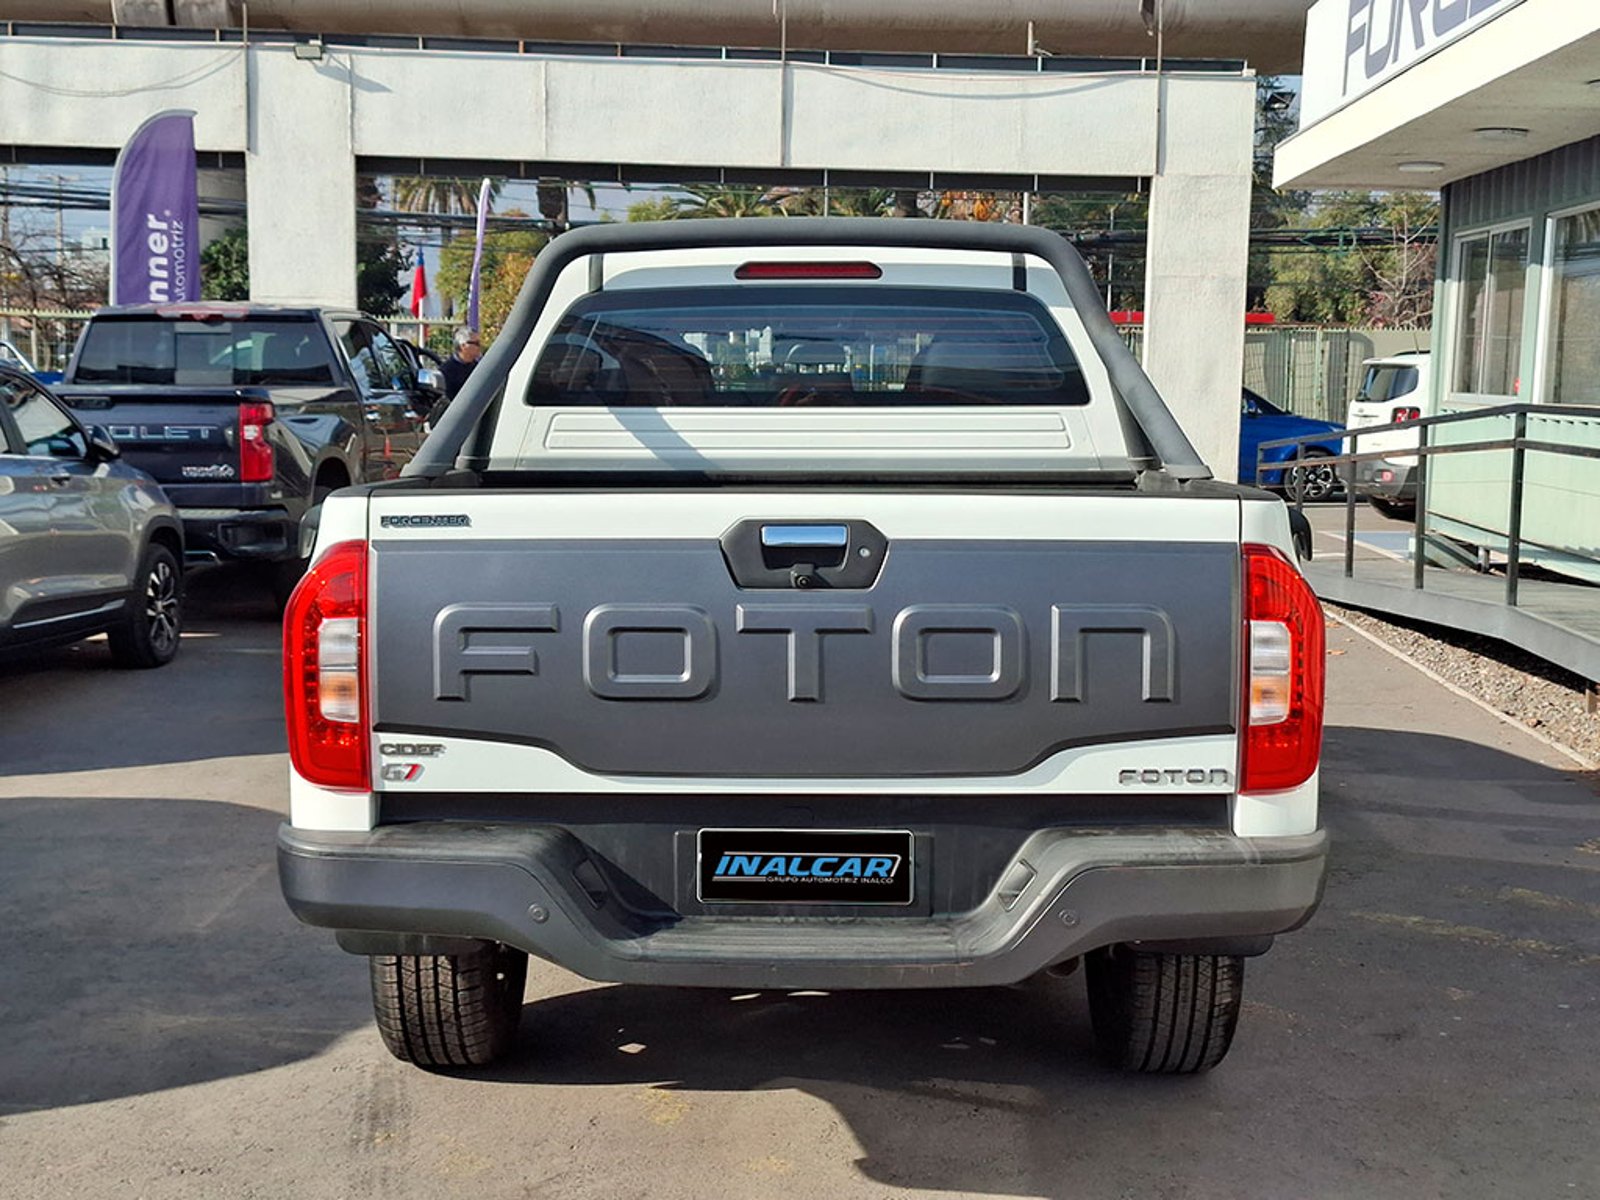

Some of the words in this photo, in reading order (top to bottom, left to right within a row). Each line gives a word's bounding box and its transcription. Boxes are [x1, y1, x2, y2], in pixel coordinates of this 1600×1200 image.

[1342, 0, 1499, 96] FOR
[84, 425, 218, 439] OLET
[432, 604, 1178, 703] FOTON
[380, 743, 447, 757] CIDEF
[381, 763, 425, 781] G7
[1119, 769, 1230, 783] FOTON
[715, 856, 893, 877] INALCAR
[767, 876, 799, 884] GRUPO
[800, 876, 858, 884] AUTOMOTRIZ
